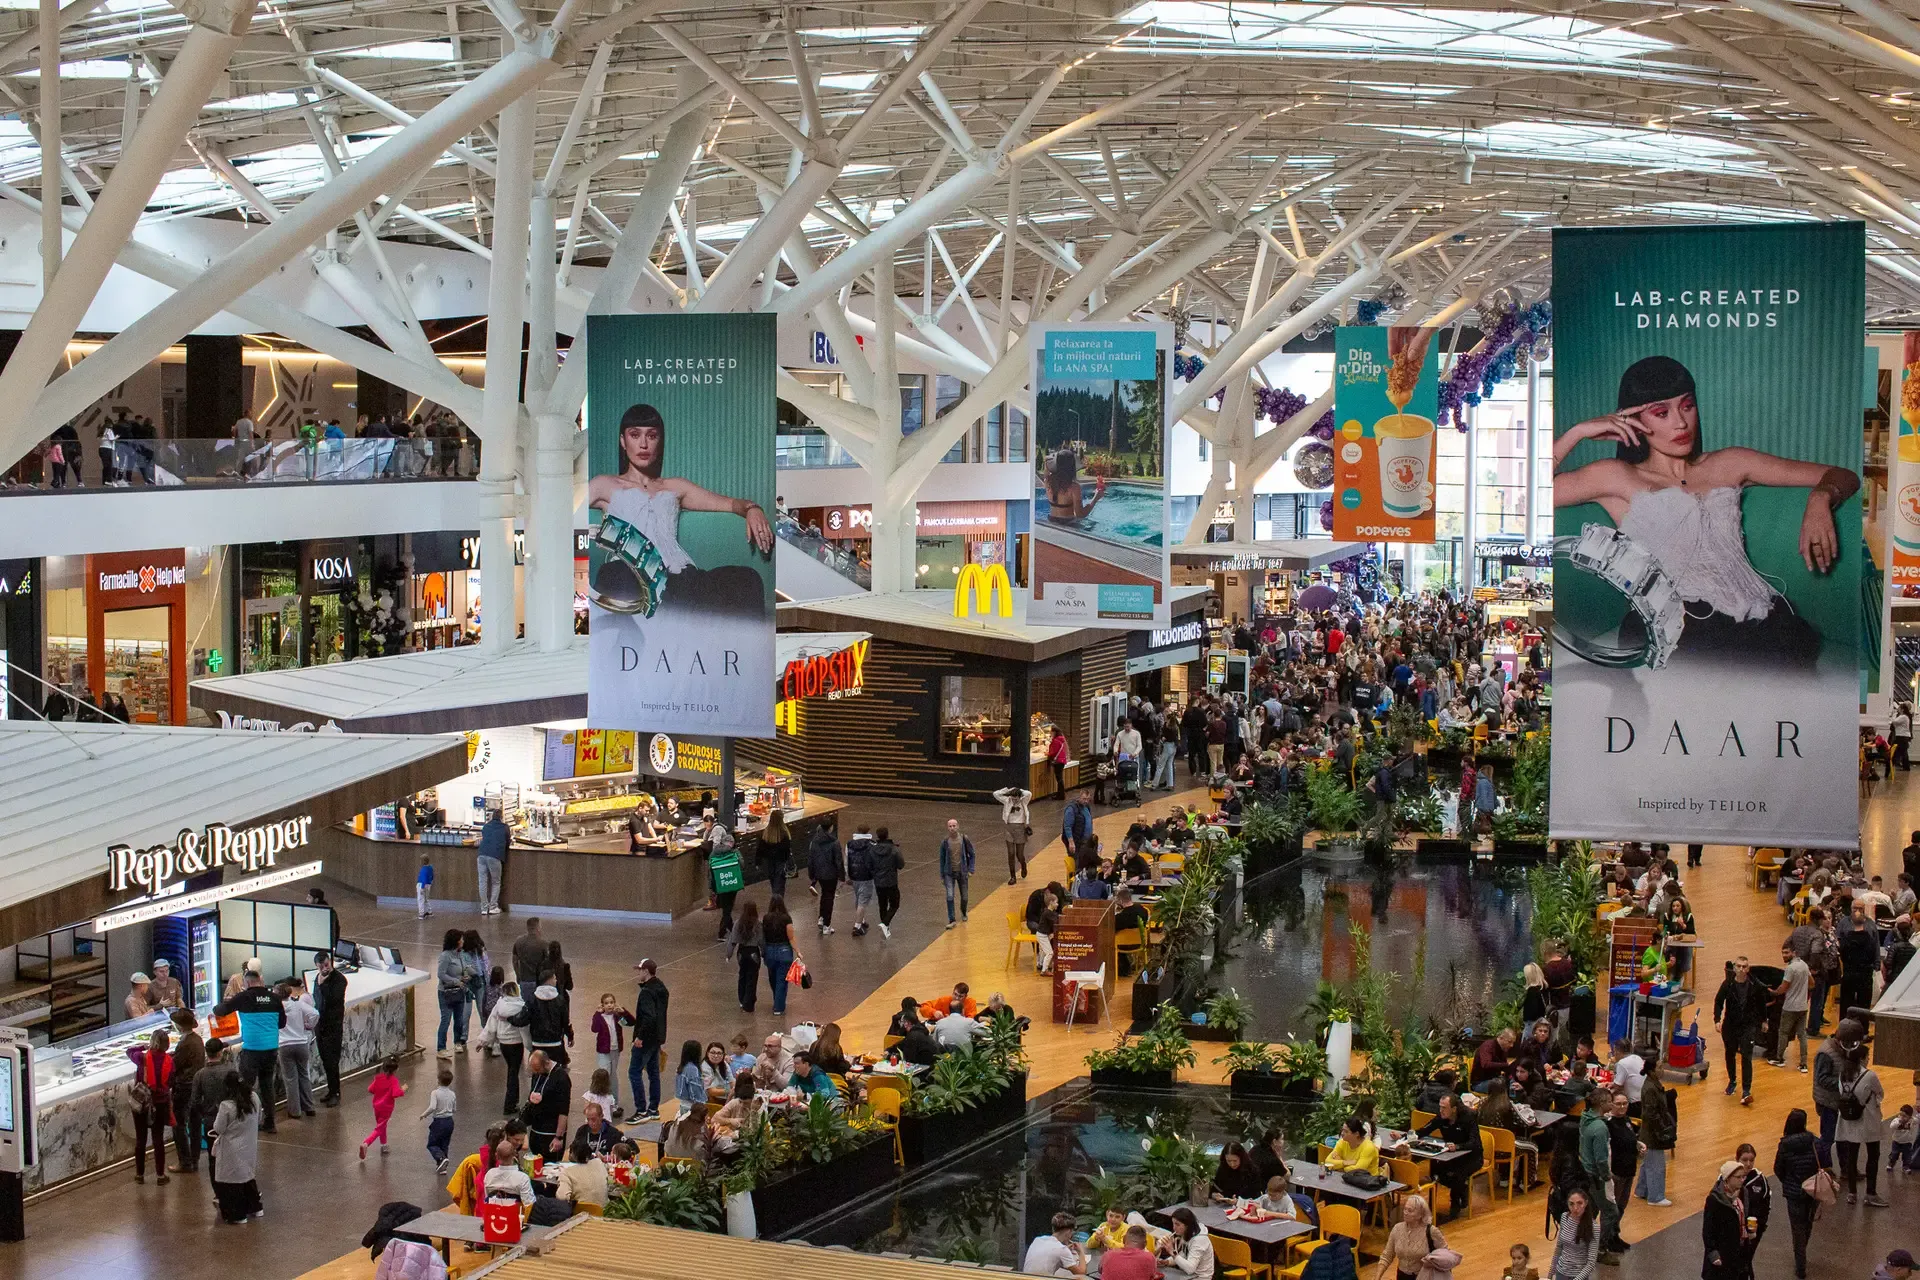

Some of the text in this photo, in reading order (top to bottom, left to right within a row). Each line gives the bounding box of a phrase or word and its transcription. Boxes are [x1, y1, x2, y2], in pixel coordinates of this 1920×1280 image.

[1614, 288, 1802, 308] LAB-CREATED
[1637, 310, 1779, 330] DIAMONDS
[1054, 339, 1101, 348] Relaxarea
[1066, 352, 1105, 363] mijlocul
[1108, 352, 1141, 360] naturii
[1348, 348, 1372, 363] Dip
[624, 356, 738, 372] LAB-CREATED
[1066, 364, 1088, 372] ANA
[1091, 364, 1113, 373] SPA!
[637, 373, 724, 386] DIAMONDS
[314, 556, 352, 580] KOSA
[156, 568, 172, 588] Help
[172, 566, 185, 585] Net
[1151, 622, 1202, 648] McDonald's
[620, 648, 741, 676] DAAR
[784, 640, 868, 700] CHOPSTIX
[844, 688, 851, 698] TO
[852, 686, 862, 696] BOX
[640, 700, 720, 714] Inspired by TEILOR
[1605, 716, 1804, 758] DAAR
[582, 746, 600, 762] XL
[714, 748, 721, 760] DE
[1638, 796, 1768, 814] Inspired by TEILOR
[110, 847, 174, 896] Pep
[207, 815, 312, 872] Pepper
[720, 872, 733, 880] Bolt
[720, 878, 738, 886] Food
